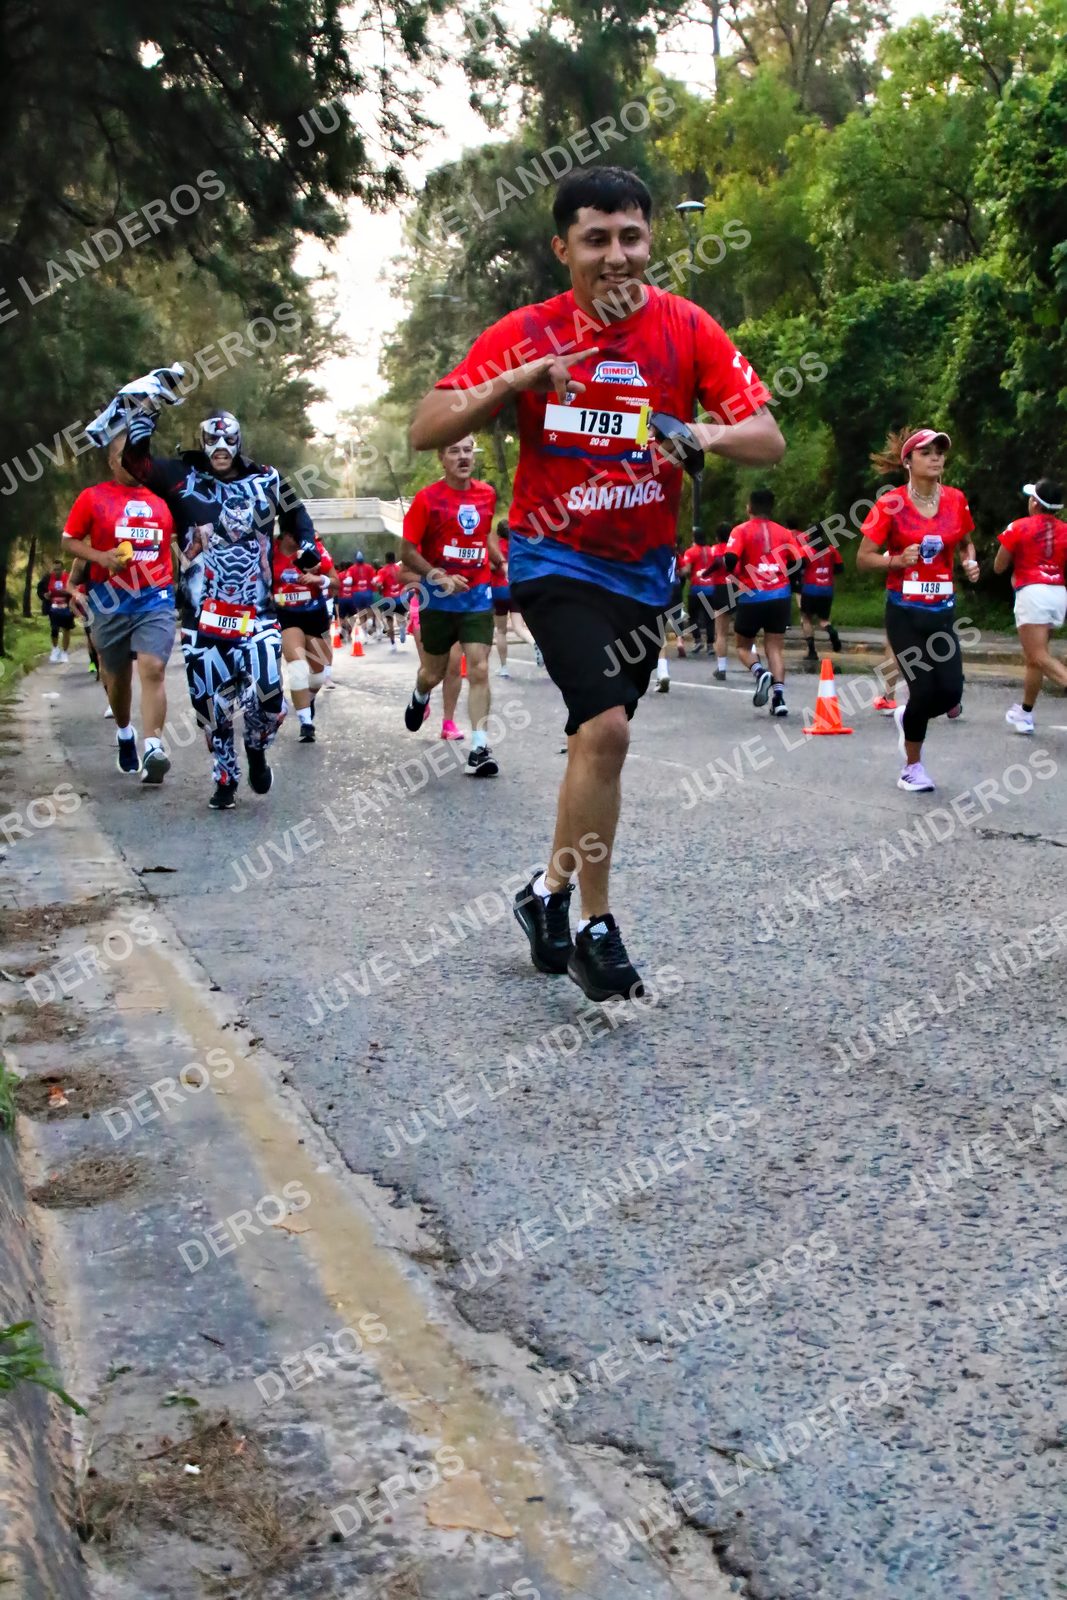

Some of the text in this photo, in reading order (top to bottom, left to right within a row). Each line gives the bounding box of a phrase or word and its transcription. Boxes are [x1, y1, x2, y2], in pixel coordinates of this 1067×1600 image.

[603, 367, 634, 375] BIMBO
[580, 410, 623, 435] 1793
[131, 528, 149, 538] 2132
[459, 549, 476, 559] 1992
[217, 615, 237, 629] 1815
